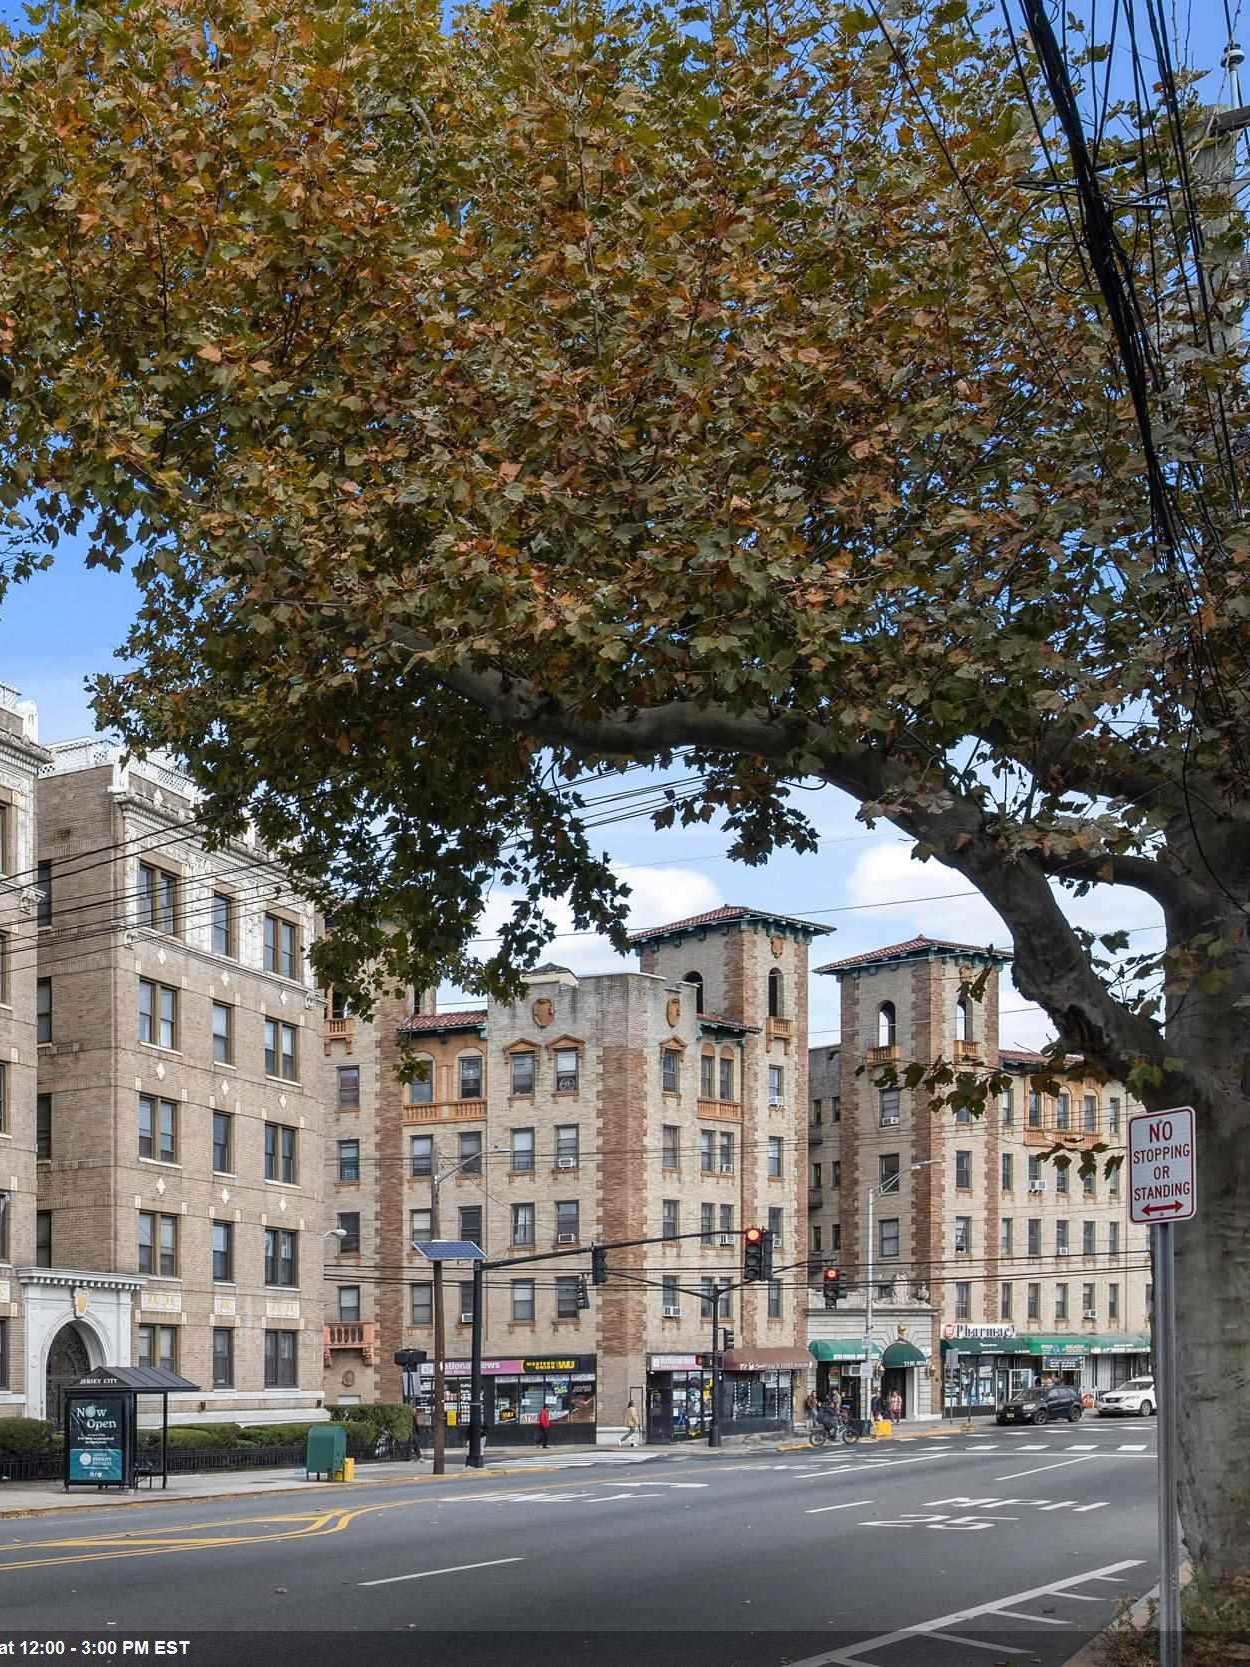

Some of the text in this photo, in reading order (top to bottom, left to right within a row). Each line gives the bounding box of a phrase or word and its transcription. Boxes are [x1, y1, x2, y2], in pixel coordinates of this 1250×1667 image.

[1149, 1120, 1173, 1143] NO
[1133, 1143, 1190, 1164] STOPPING
[1153, 1165, 1170, 1180] OR
[1134, 1181, 1190, 1201] STANDING
[957, 1324, 1016, 1338] Pharmacy
[86, 1419, 117, 1430] Open
[921, 1497, 1111, 1512] MPH
[857, 1514, 1020, 1530] 25
